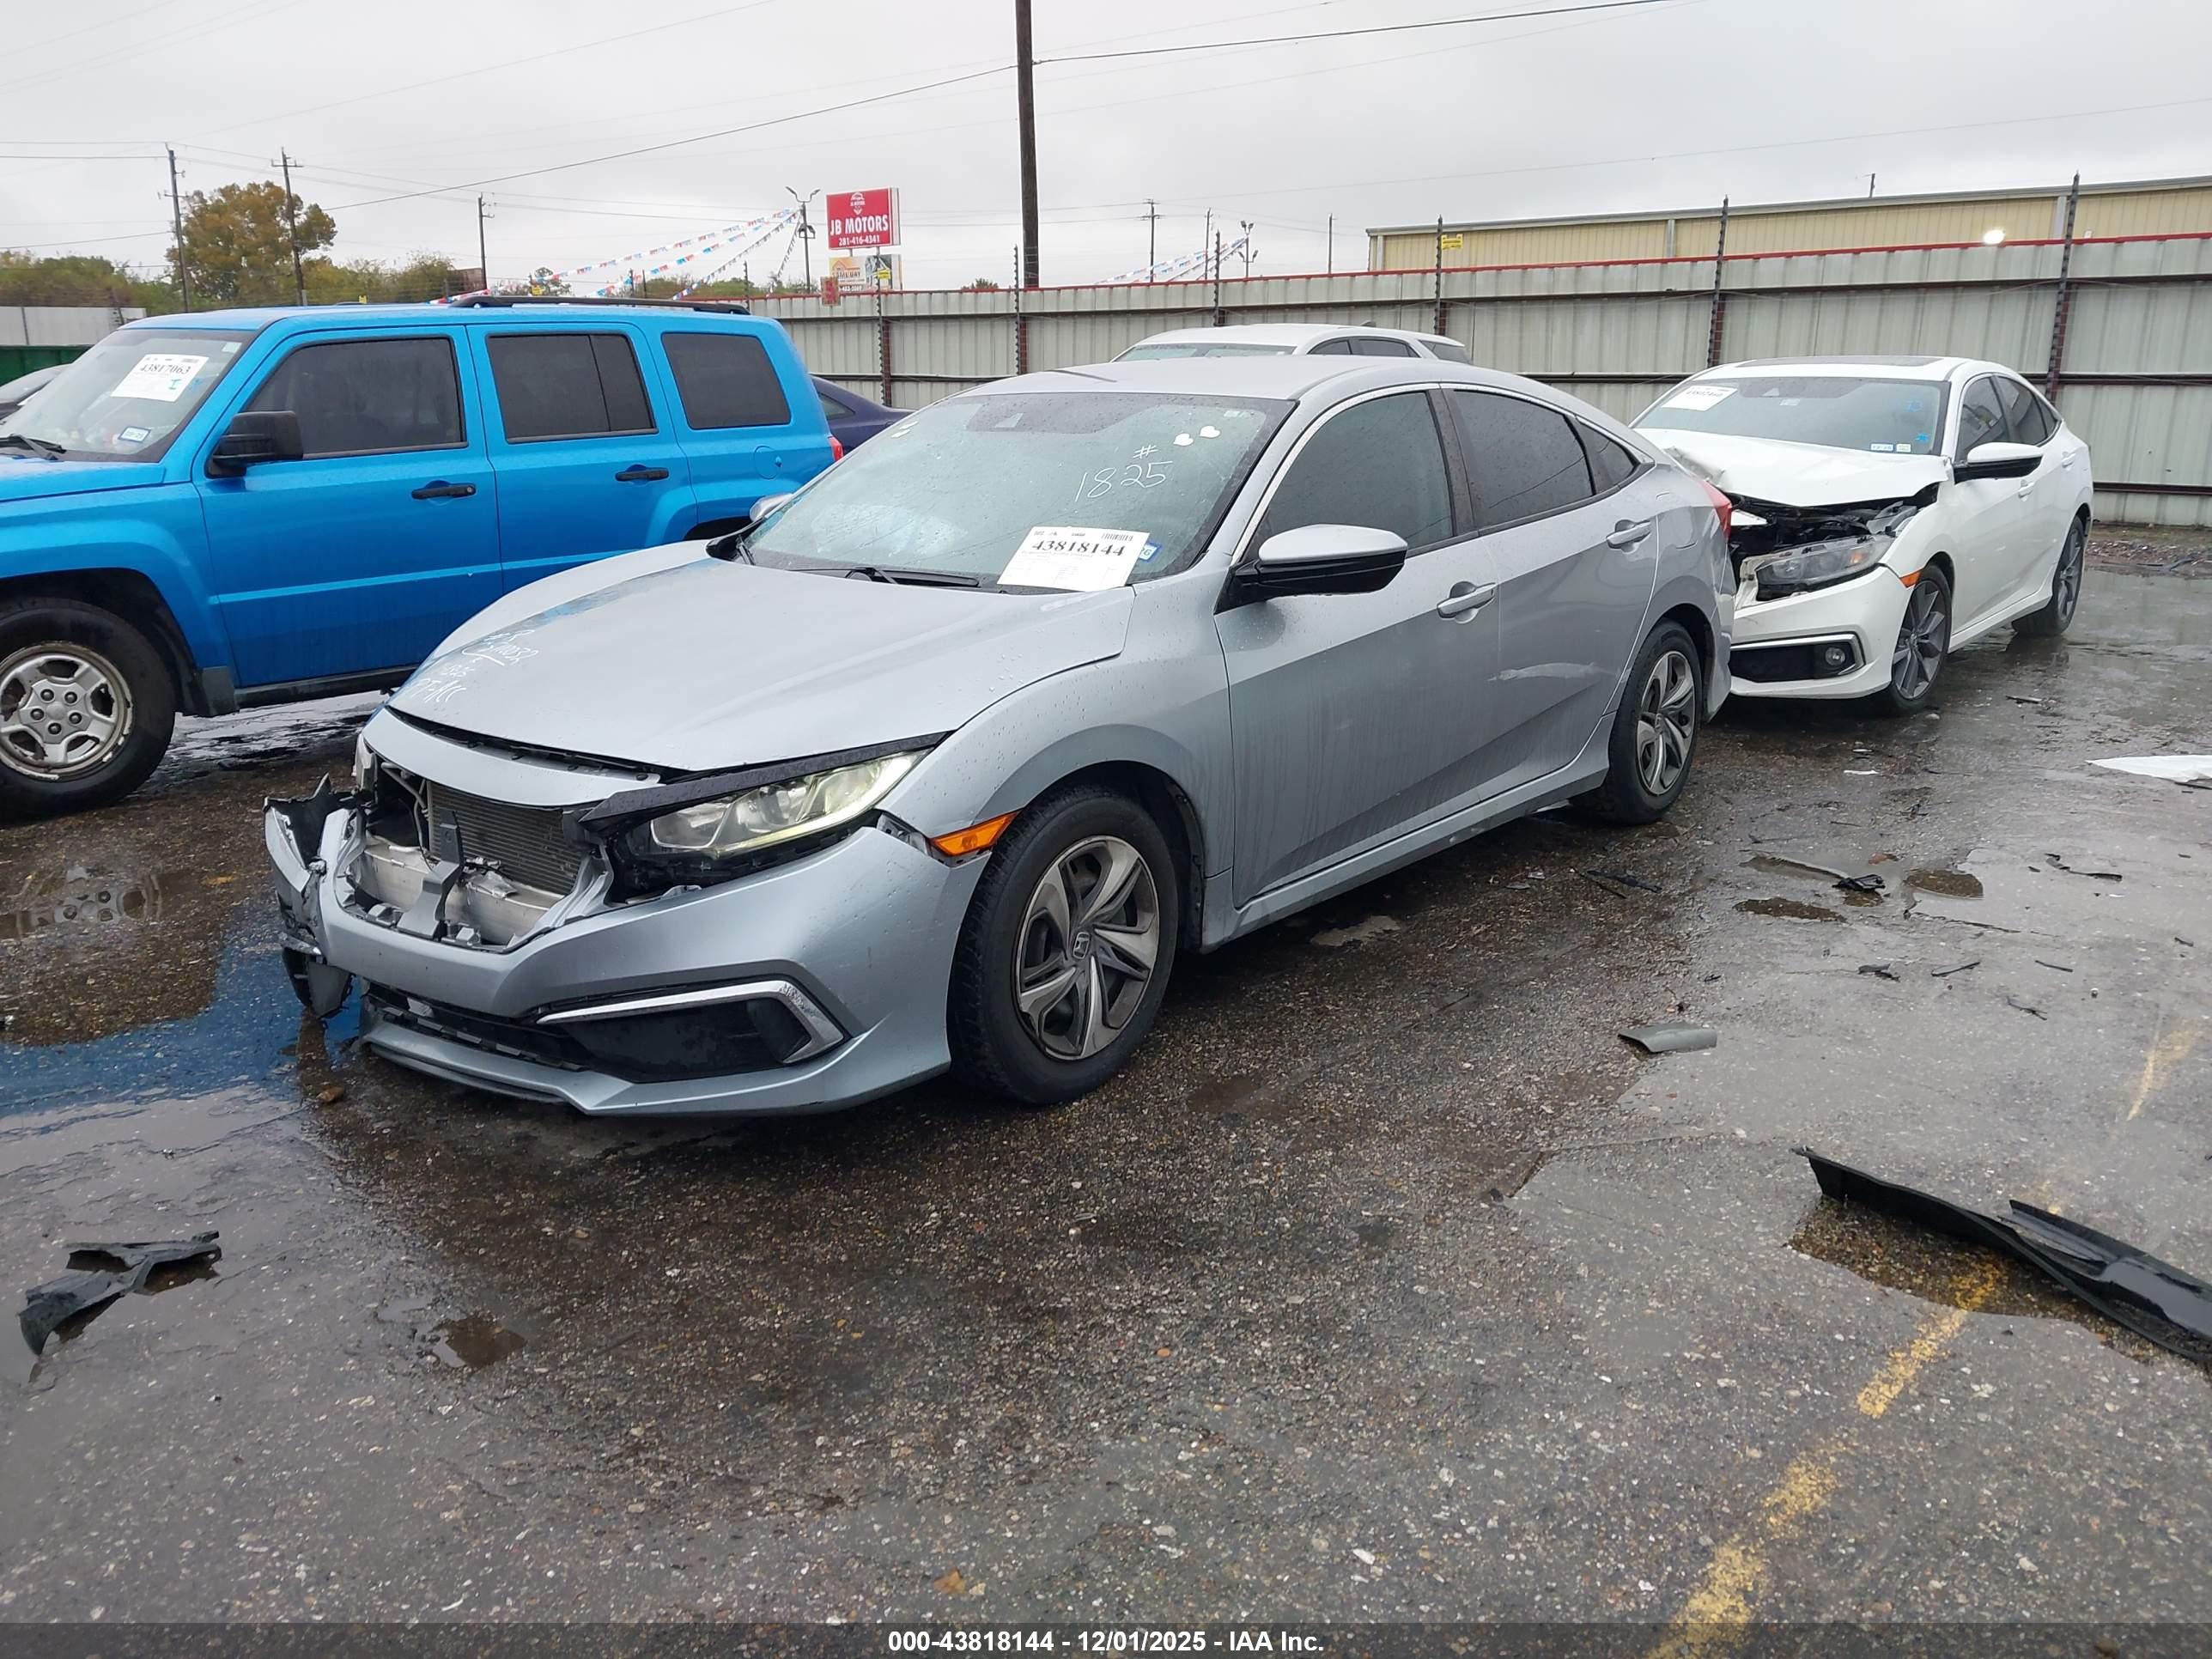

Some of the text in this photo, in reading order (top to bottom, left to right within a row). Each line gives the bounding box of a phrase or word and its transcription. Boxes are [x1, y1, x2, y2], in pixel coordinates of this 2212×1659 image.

[830, 215, 889, 235] JB MOTORS
[839, 234, 880, 246] 281-416-4341
[1133, 445, 1158, 459] #
[1074, 461, 1173, 502] 1825
[1032, 540, 1126, 556] 43818144
